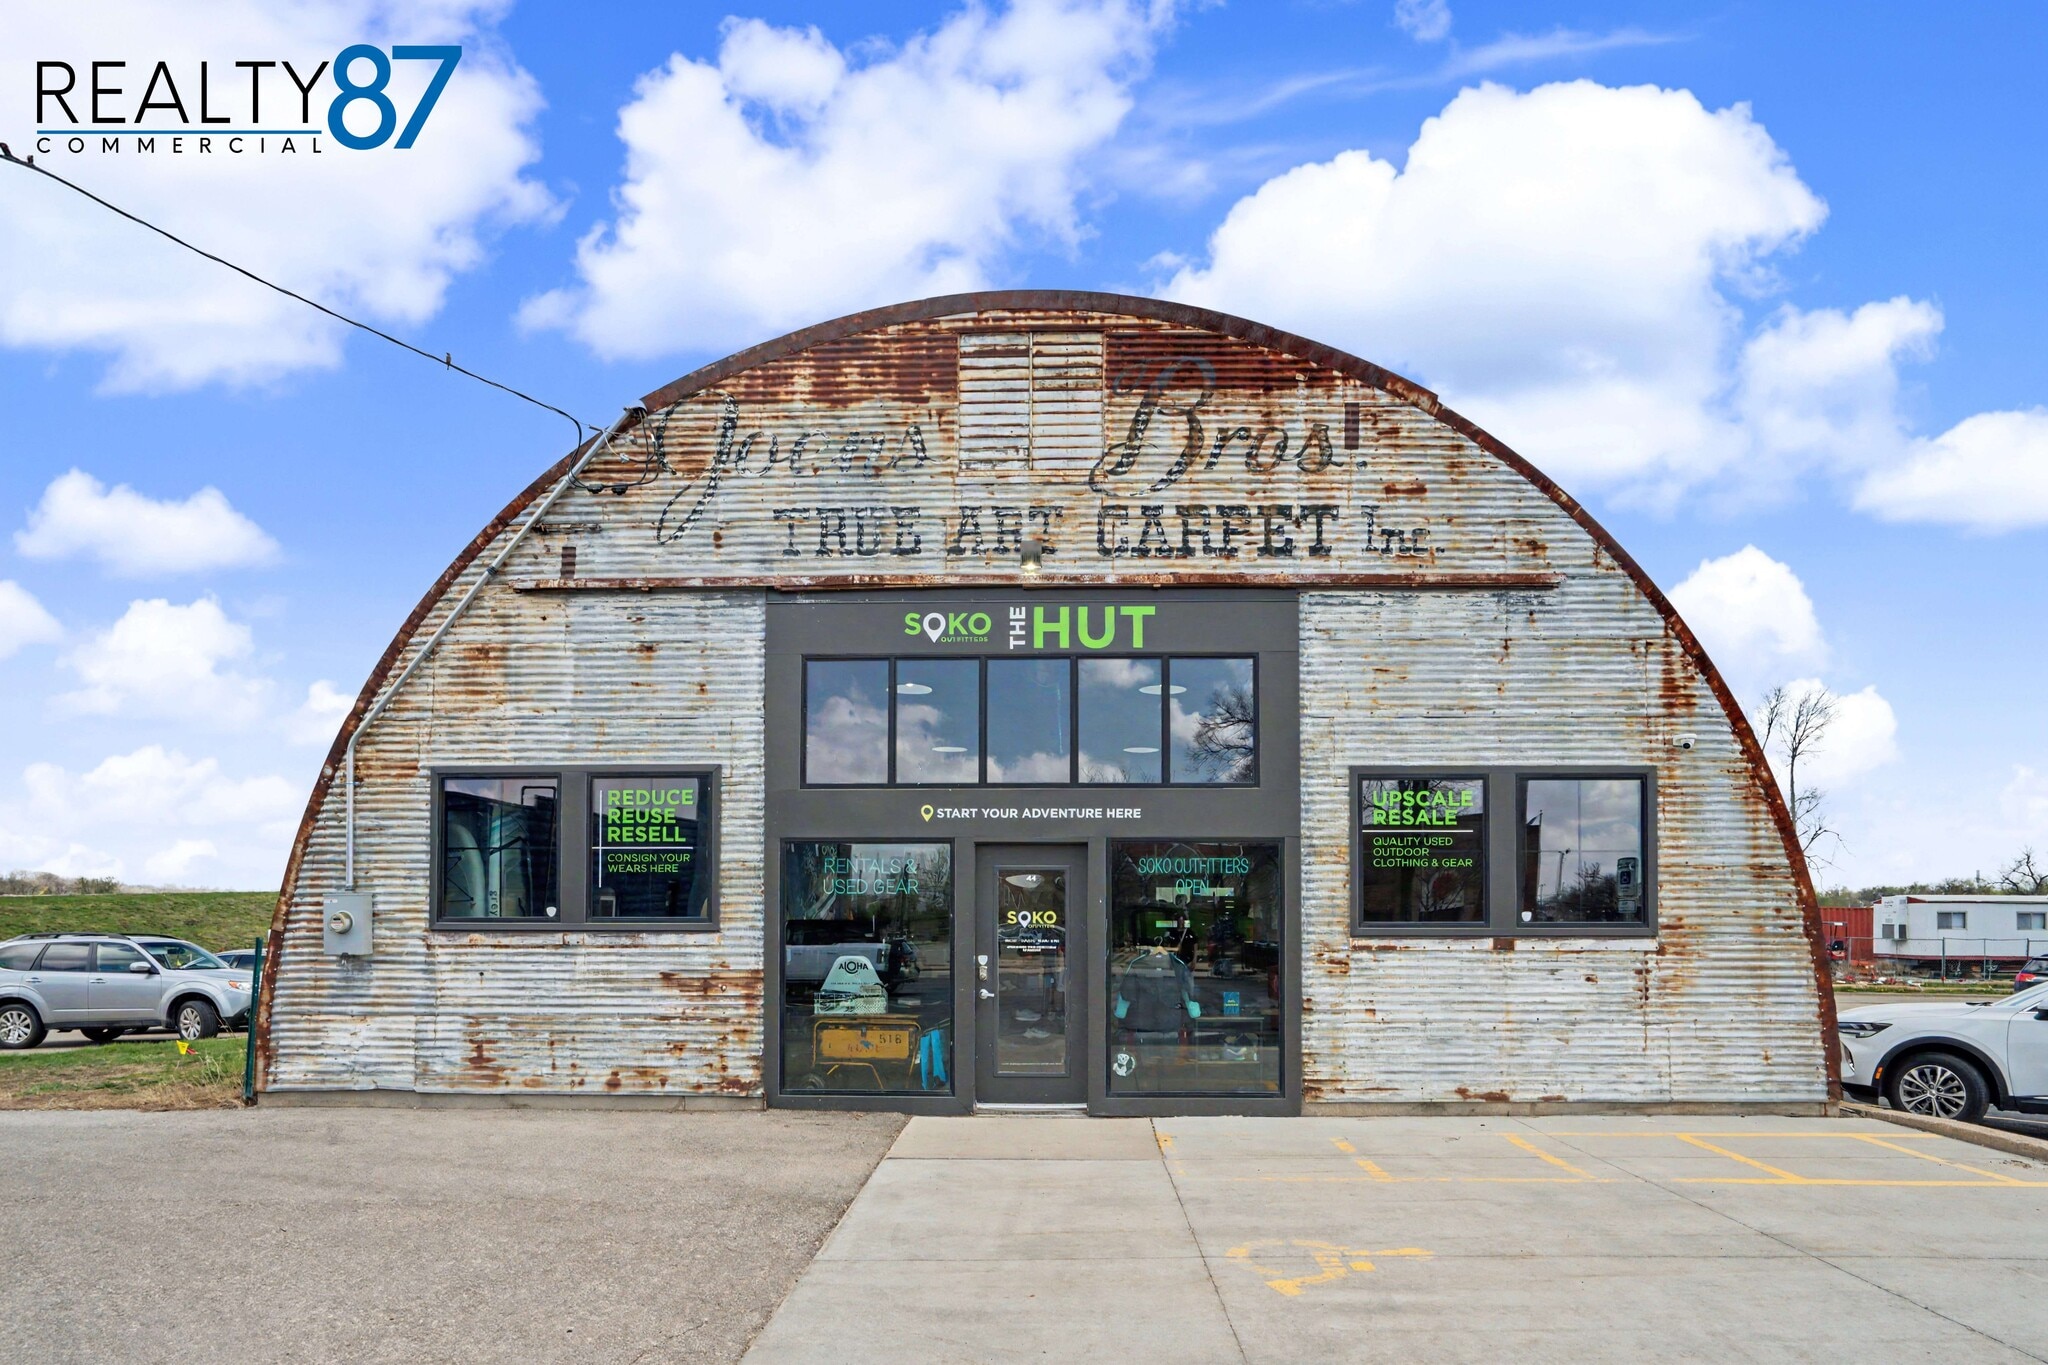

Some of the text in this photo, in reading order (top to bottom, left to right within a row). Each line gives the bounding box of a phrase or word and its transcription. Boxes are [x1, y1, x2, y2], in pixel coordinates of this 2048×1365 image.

[773, 507, 922, 557] TRUE
[947, 505, 1064, 555] ART
[1098, 504, 1340, 558] CARPET
[904, 612, 992, 644] SOKO
[1009, 606, 1026, 650] THE
[1033, 605, 1157, 649] HUT
[607, 789, 694, 806] REDUCE
[1372, 790, 1474, 807] UPSCALE
[607, 808, 677, 824] REUSE
[937, 808, 1142, 819] START YOUR ADVENTURE HERE
[1373, 809, 1458, 826] RESALE
[607, 826, 687, 843] RESELL
[1373, 837, 1453, 846] QUALITY USED
[607, 853, 691, 862] CONSIGN YOUR
[1373, 847, 1430, 857] OUTDOOR
[608, 864, 679, 873] WEARS HERE
[823, 858, 917, 874] RENTALS &
[1138, 857, 1249, 874] SOKO OUTFITTERS
[1373, 858, 1473, 868] CLOTHING & GEAR
[822, 879, 920, 894] USED GEAR
[1175, 879, 1210, 895] OPEN
[1007, 910, 1057, 929] SOKO
[838, 961, 869, 974] ALOHA
